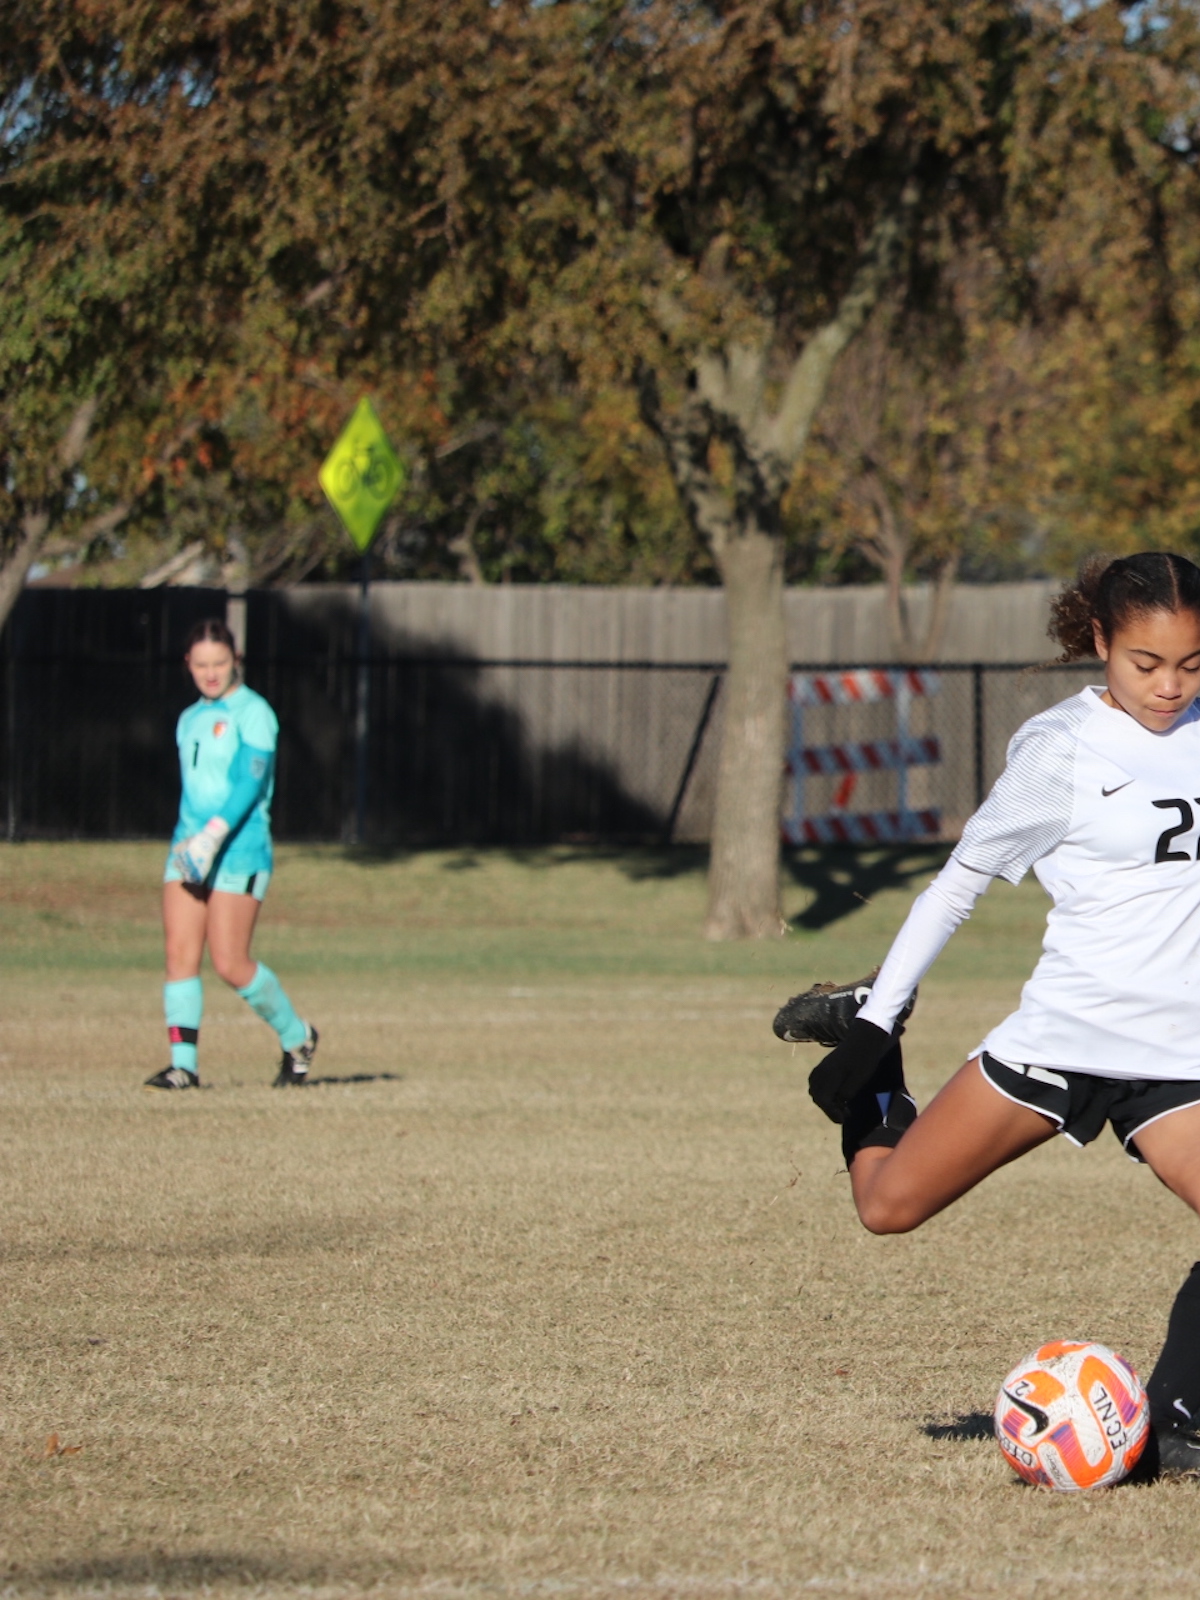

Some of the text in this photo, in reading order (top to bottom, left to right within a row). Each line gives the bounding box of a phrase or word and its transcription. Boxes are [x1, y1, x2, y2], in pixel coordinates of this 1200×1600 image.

[193, 741, 200, 768] 1
[1015, 1380, 1030, 1397] 2
[1094, 1386, 1127, 1451] ECNL
